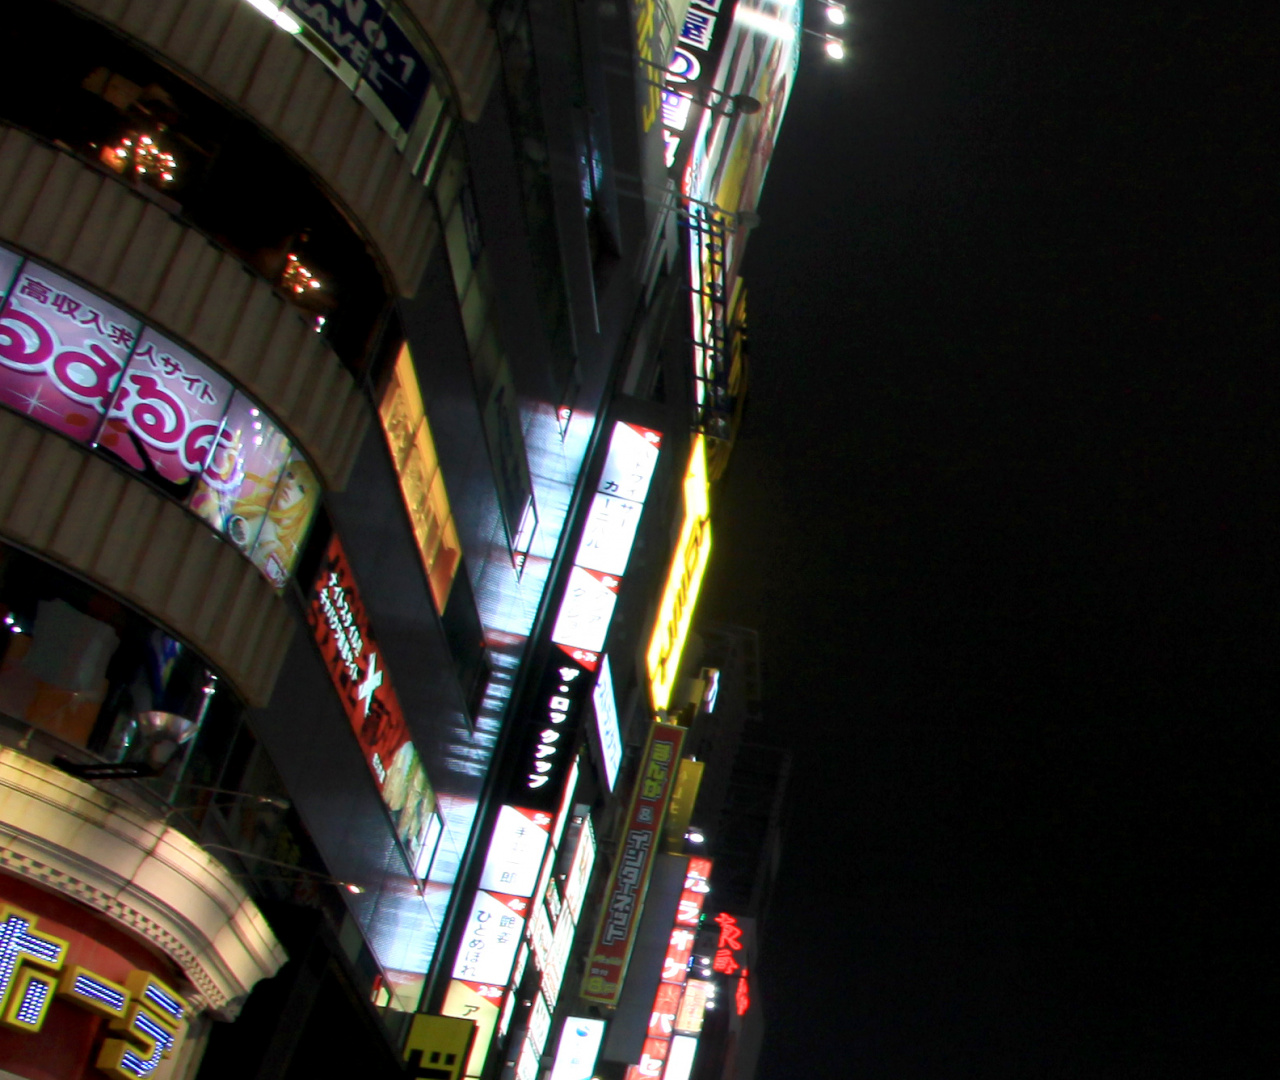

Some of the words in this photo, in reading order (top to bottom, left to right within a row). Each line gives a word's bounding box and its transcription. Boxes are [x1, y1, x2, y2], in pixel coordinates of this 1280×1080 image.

[22, 276, 217, 404] 高収入求人サイト
[661, 870, 711, 979] カラオケ
